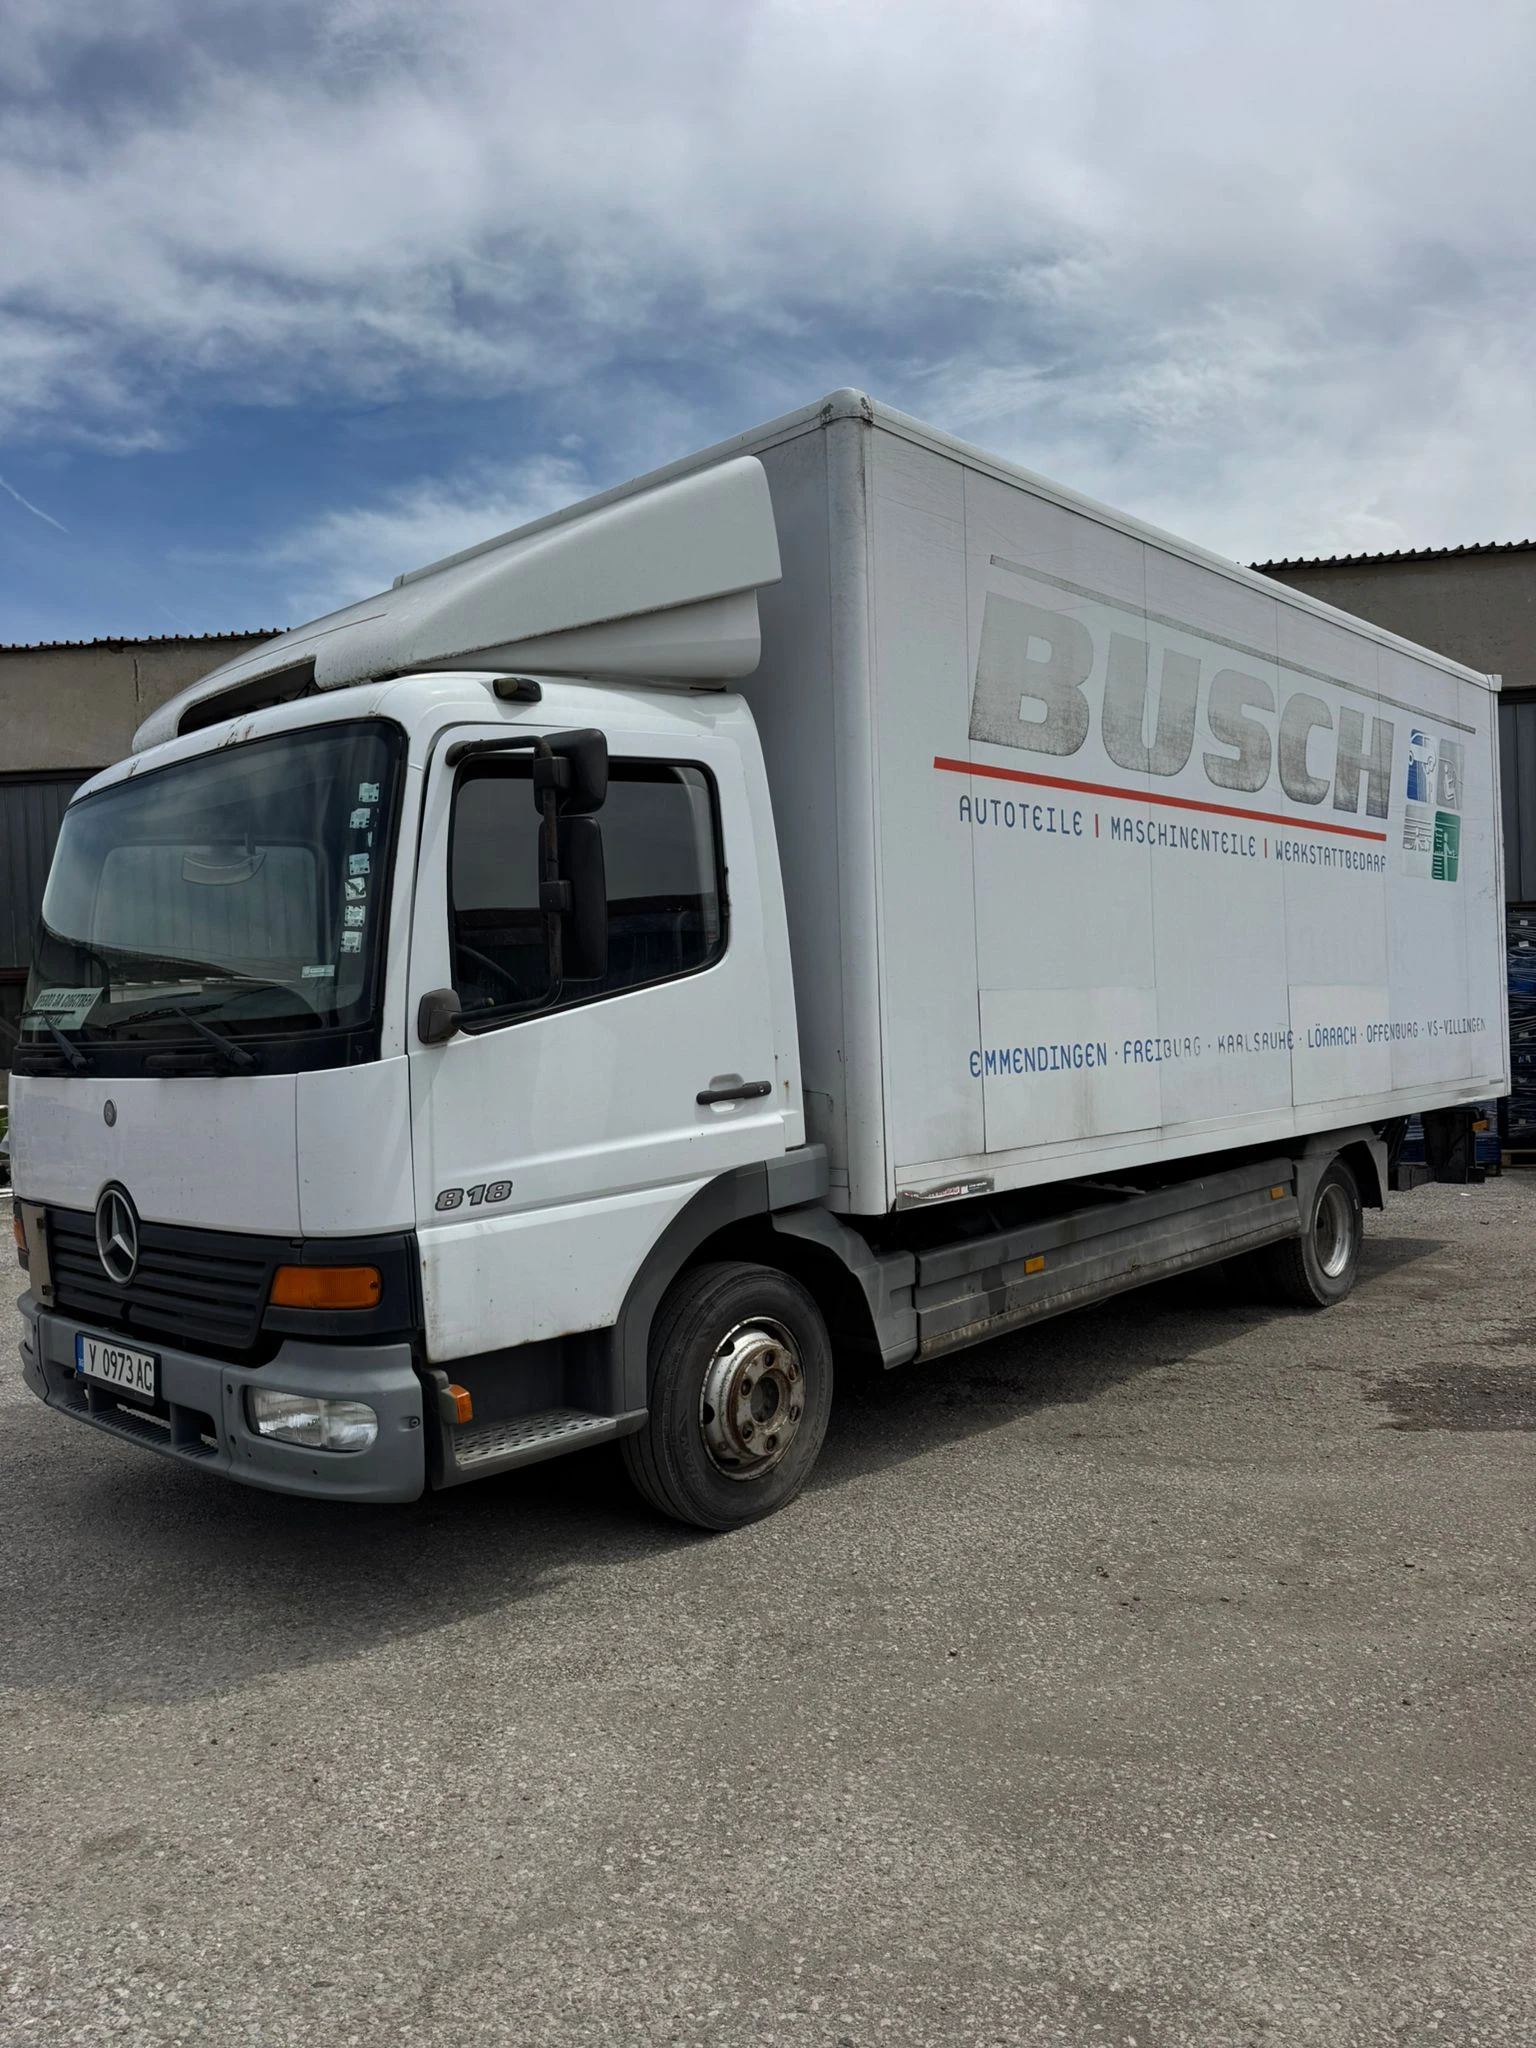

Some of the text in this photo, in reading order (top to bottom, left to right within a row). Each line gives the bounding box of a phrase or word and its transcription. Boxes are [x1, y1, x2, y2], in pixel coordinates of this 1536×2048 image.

[968, 591, 1394, 820] BUSCH
[959, 795, 1386, 873] AUTOTEILE MASCHINENTEILE WERKSTATTBEDARF
[969, 1017, 1486, 1078] EMMENDINGEN FREIBURG KARLSRUHE LÖRRACH OFFENBURG VS-VILLINGEN
[435, 1180, 513, 1211] 818
[89, 1343, 153, 1391] Y 0973 AC
